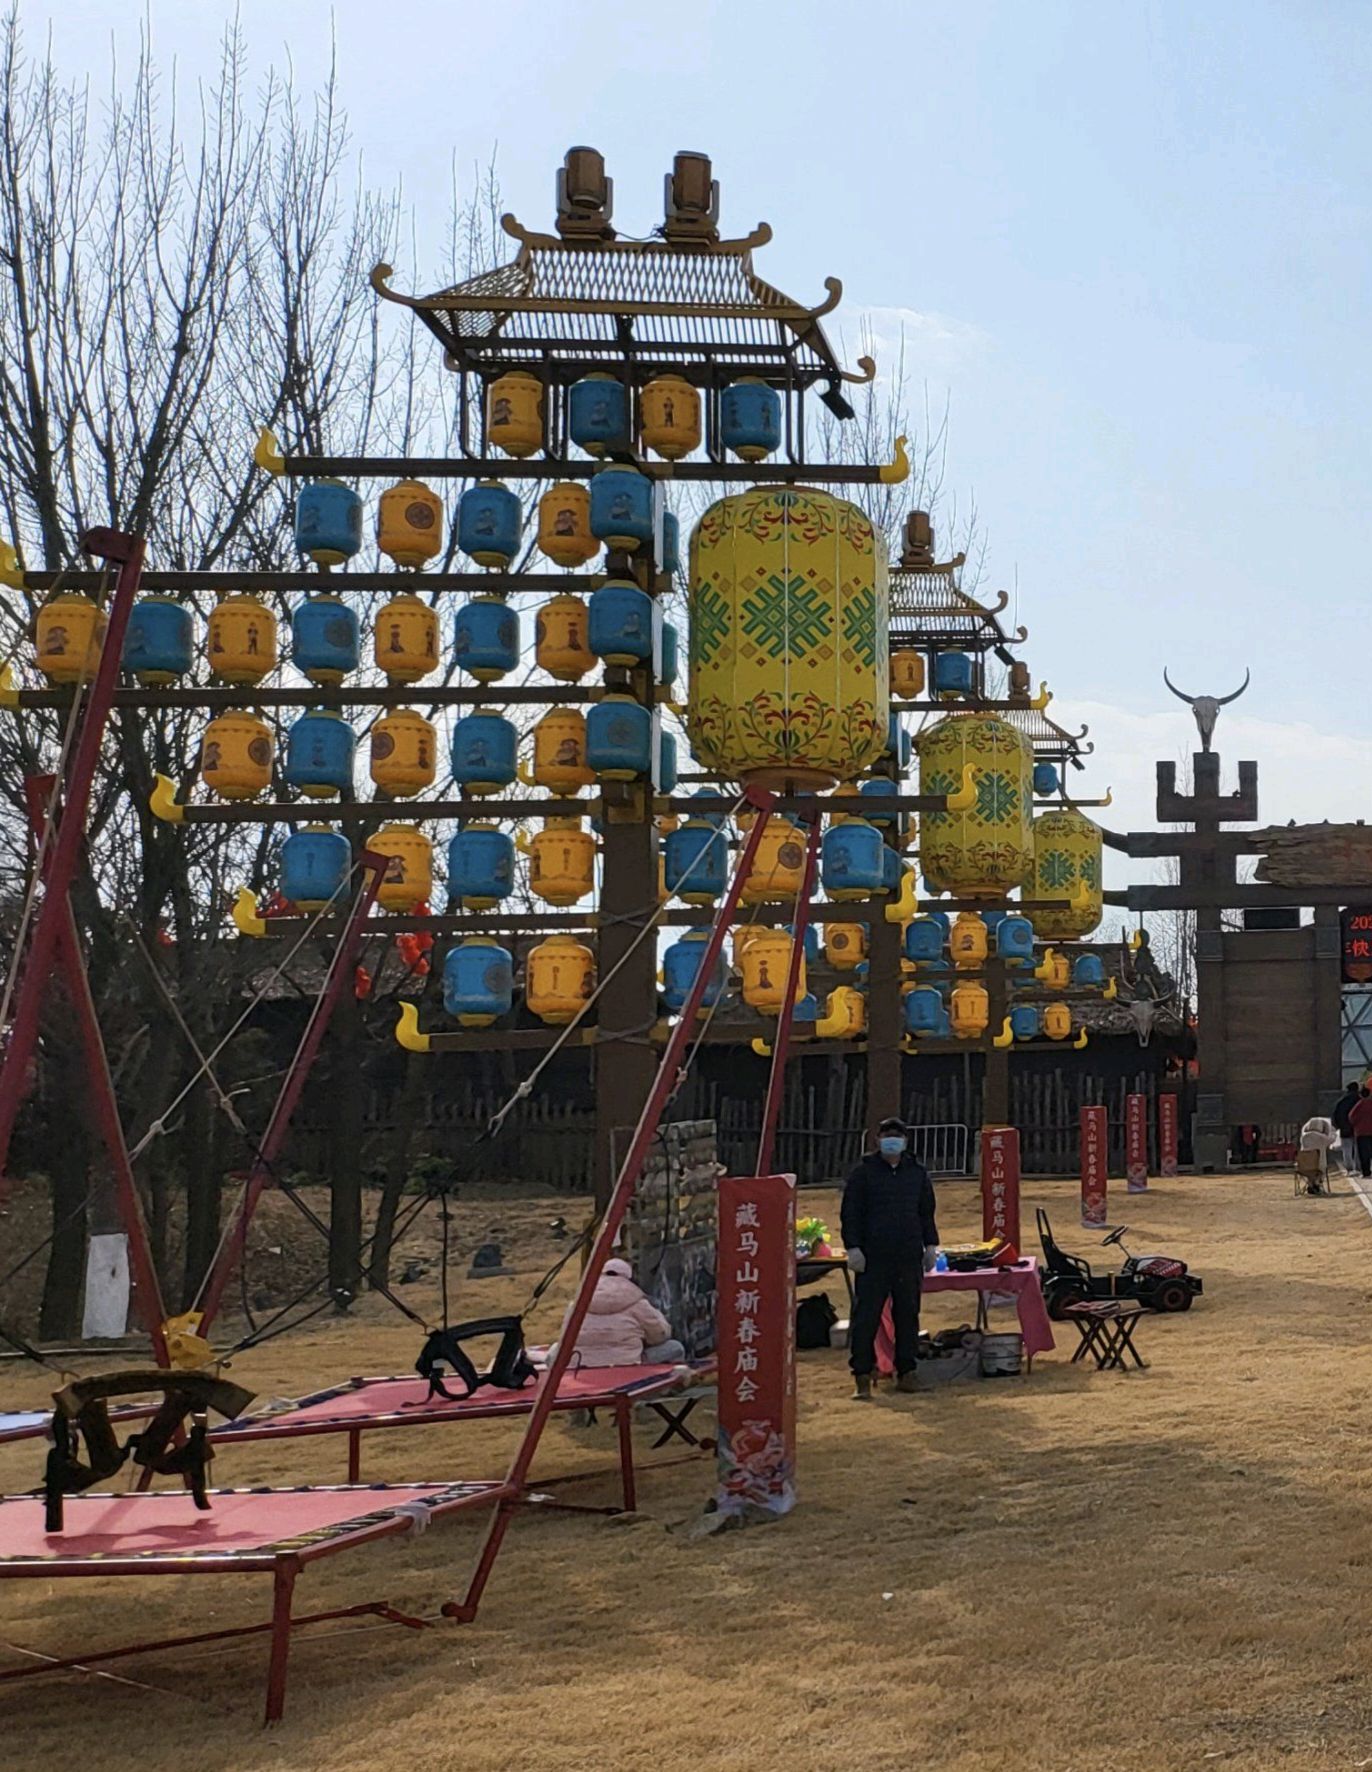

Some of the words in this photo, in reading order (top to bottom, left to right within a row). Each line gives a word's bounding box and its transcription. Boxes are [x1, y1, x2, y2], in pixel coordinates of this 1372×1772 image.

[733, 1202, 762, 1402] 藏马山新春庙会
